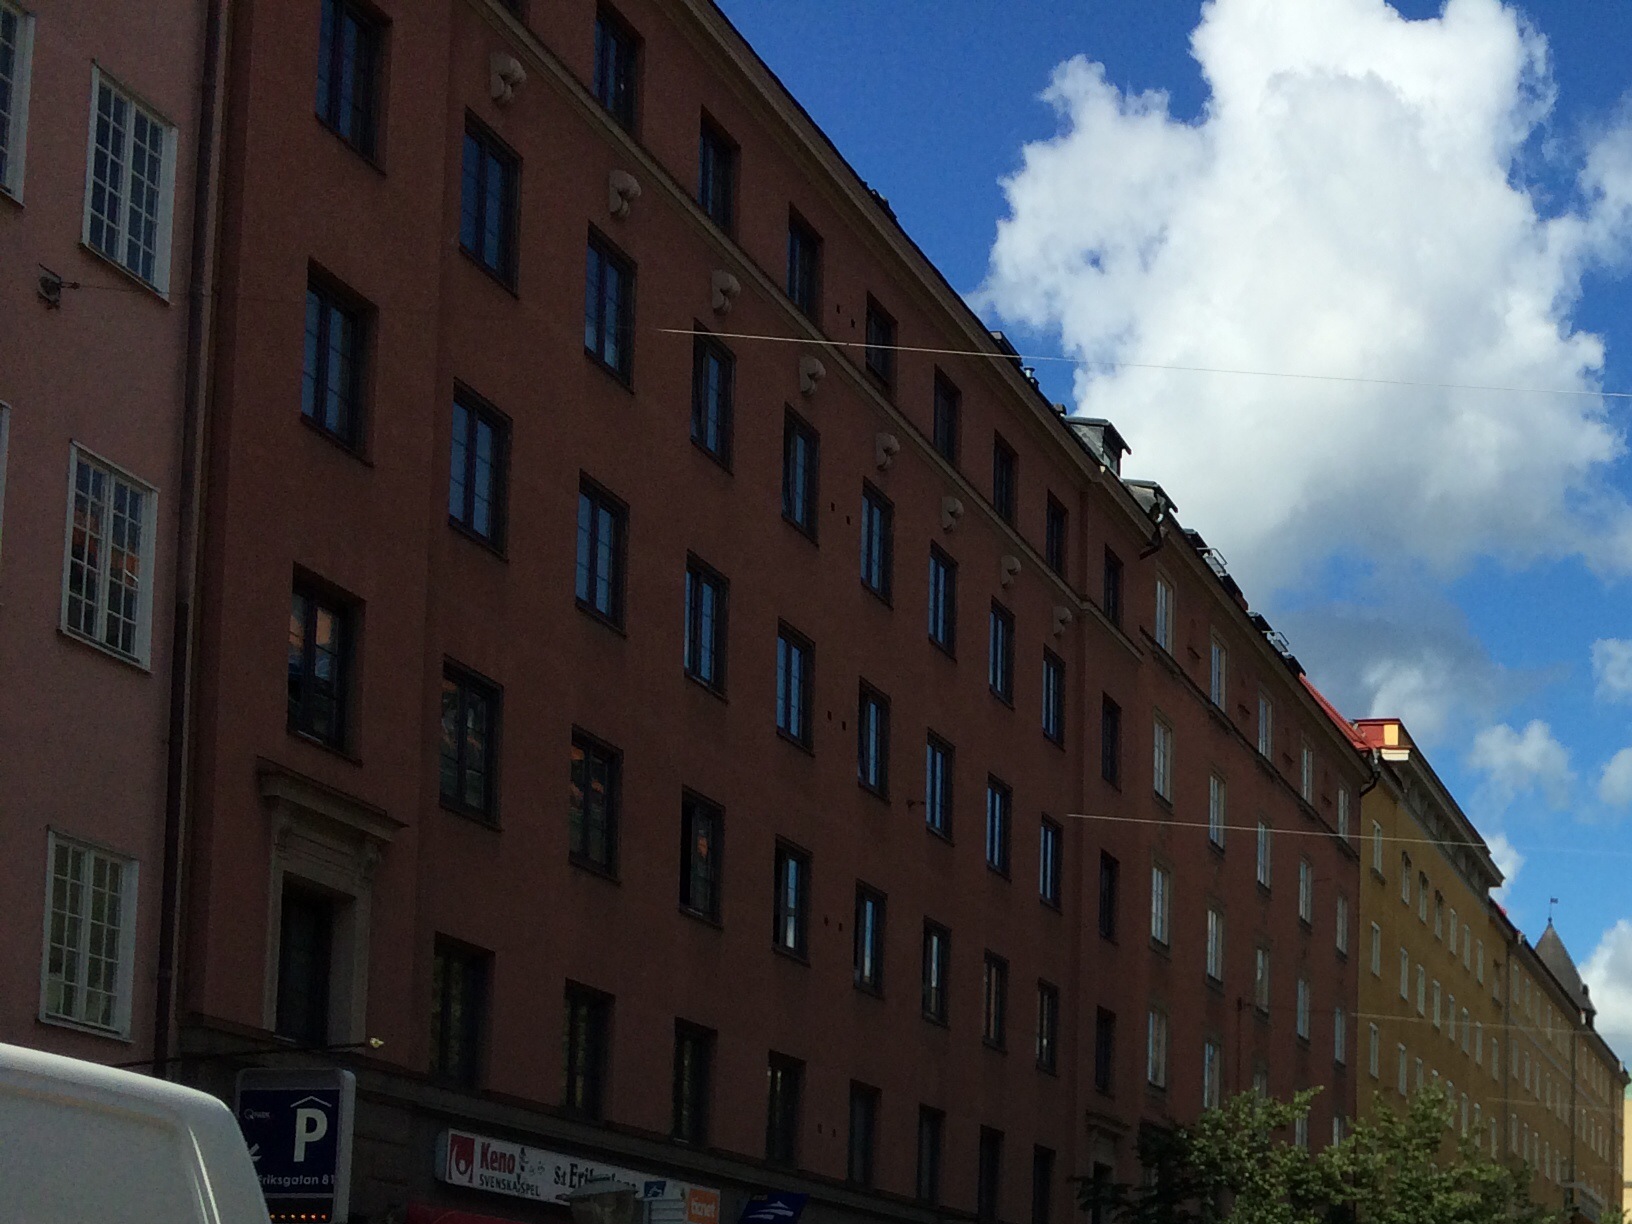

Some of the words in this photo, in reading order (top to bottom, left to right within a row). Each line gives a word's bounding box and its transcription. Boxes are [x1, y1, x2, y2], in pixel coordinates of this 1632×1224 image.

[293, 1108, 329, 1162] P
[481, 1141, 517, 1175] Keno
[480, 1173, 519, 1194] SVENSKA
[520, 1180, 541, 1198] SPEL
